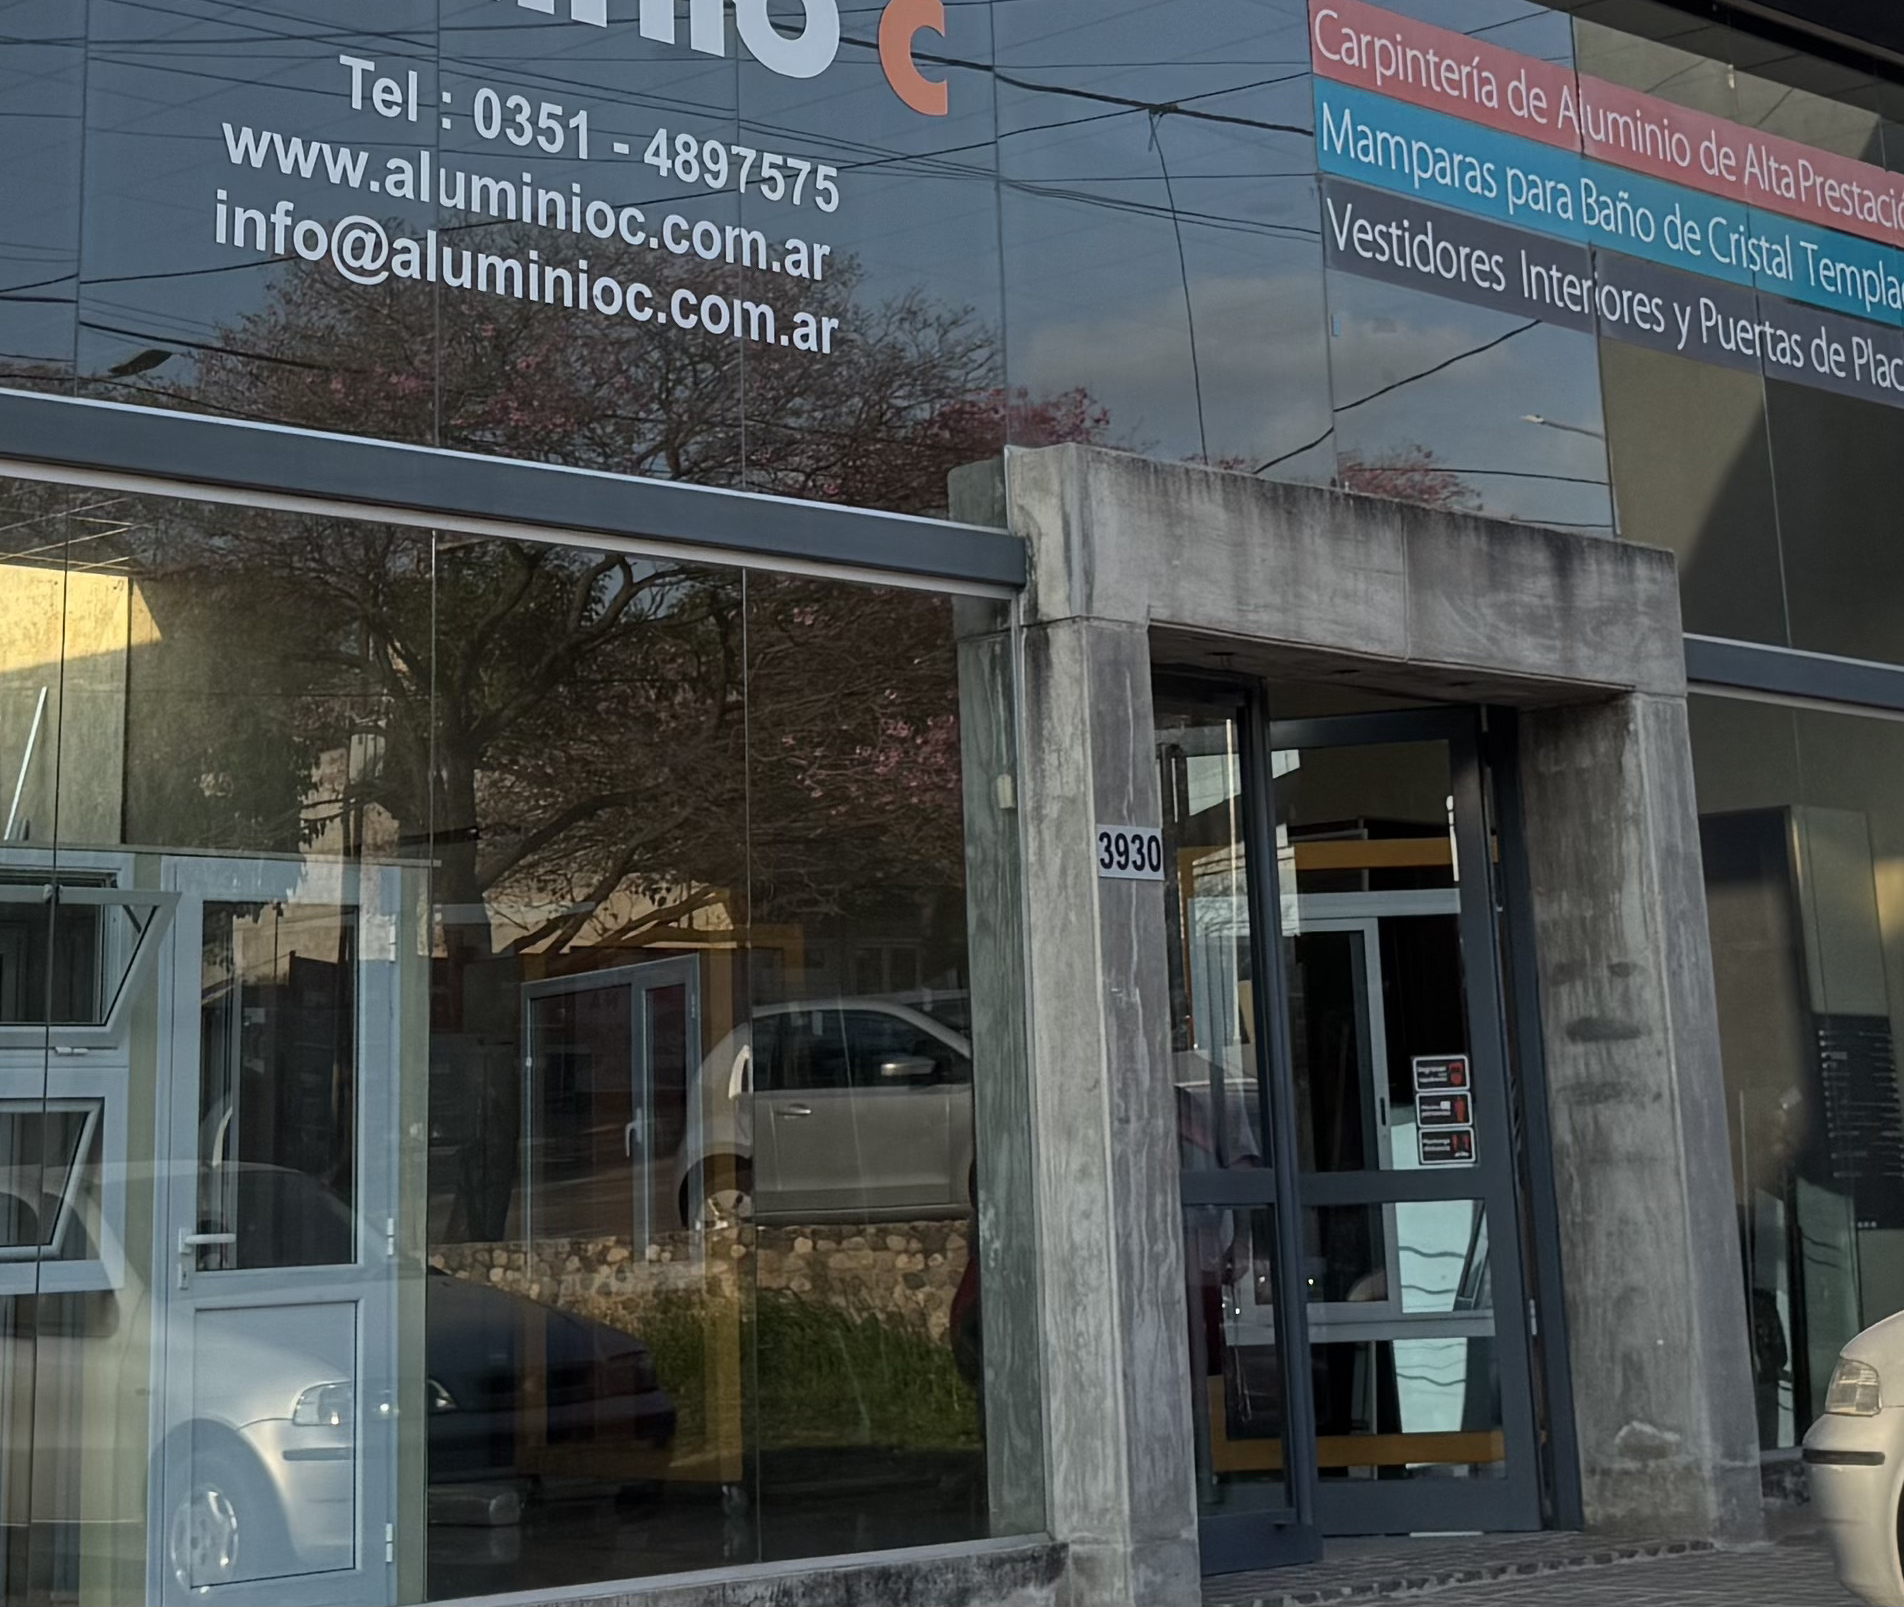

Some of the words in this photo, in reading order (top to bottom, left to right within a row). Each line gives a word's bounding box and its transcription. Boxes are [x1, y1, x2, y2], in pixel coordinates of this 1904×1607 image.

[339, 54, 418, 122] Tel
[474, 87, 588, 160] 0351
[643, 128, 839, 213] 4897575
[1314, 9, 1498, 109] Carpintería
[1507, 68, 1548, 124] de
[1558, 85, 1691, 168] Aluminio
[1699, 129, 1737, 182] de
[216, 188, 839, 354] info@aluminioc.com.ar
[222, 122, 832, 282] www.aluminioc.com.ar
[1322, 102, 1497, 198] Mamparas
[1506, 165, 1574, 221] para
[1580, 177, 1656, 243] Baño
[1663, 203, 1701, 256] de
[1708, 216, 1794, 282] Cristal
[1326, 197, 1506, 292] Vestidores
[1520, 249, 1665, 333] Interiores
[1673, 302, 1692, 351] y
[1699, 297, 1804, 368] Puertas
[1811, 325, 1847, 378] de
[1099, 831, 1162, 873] 3930
